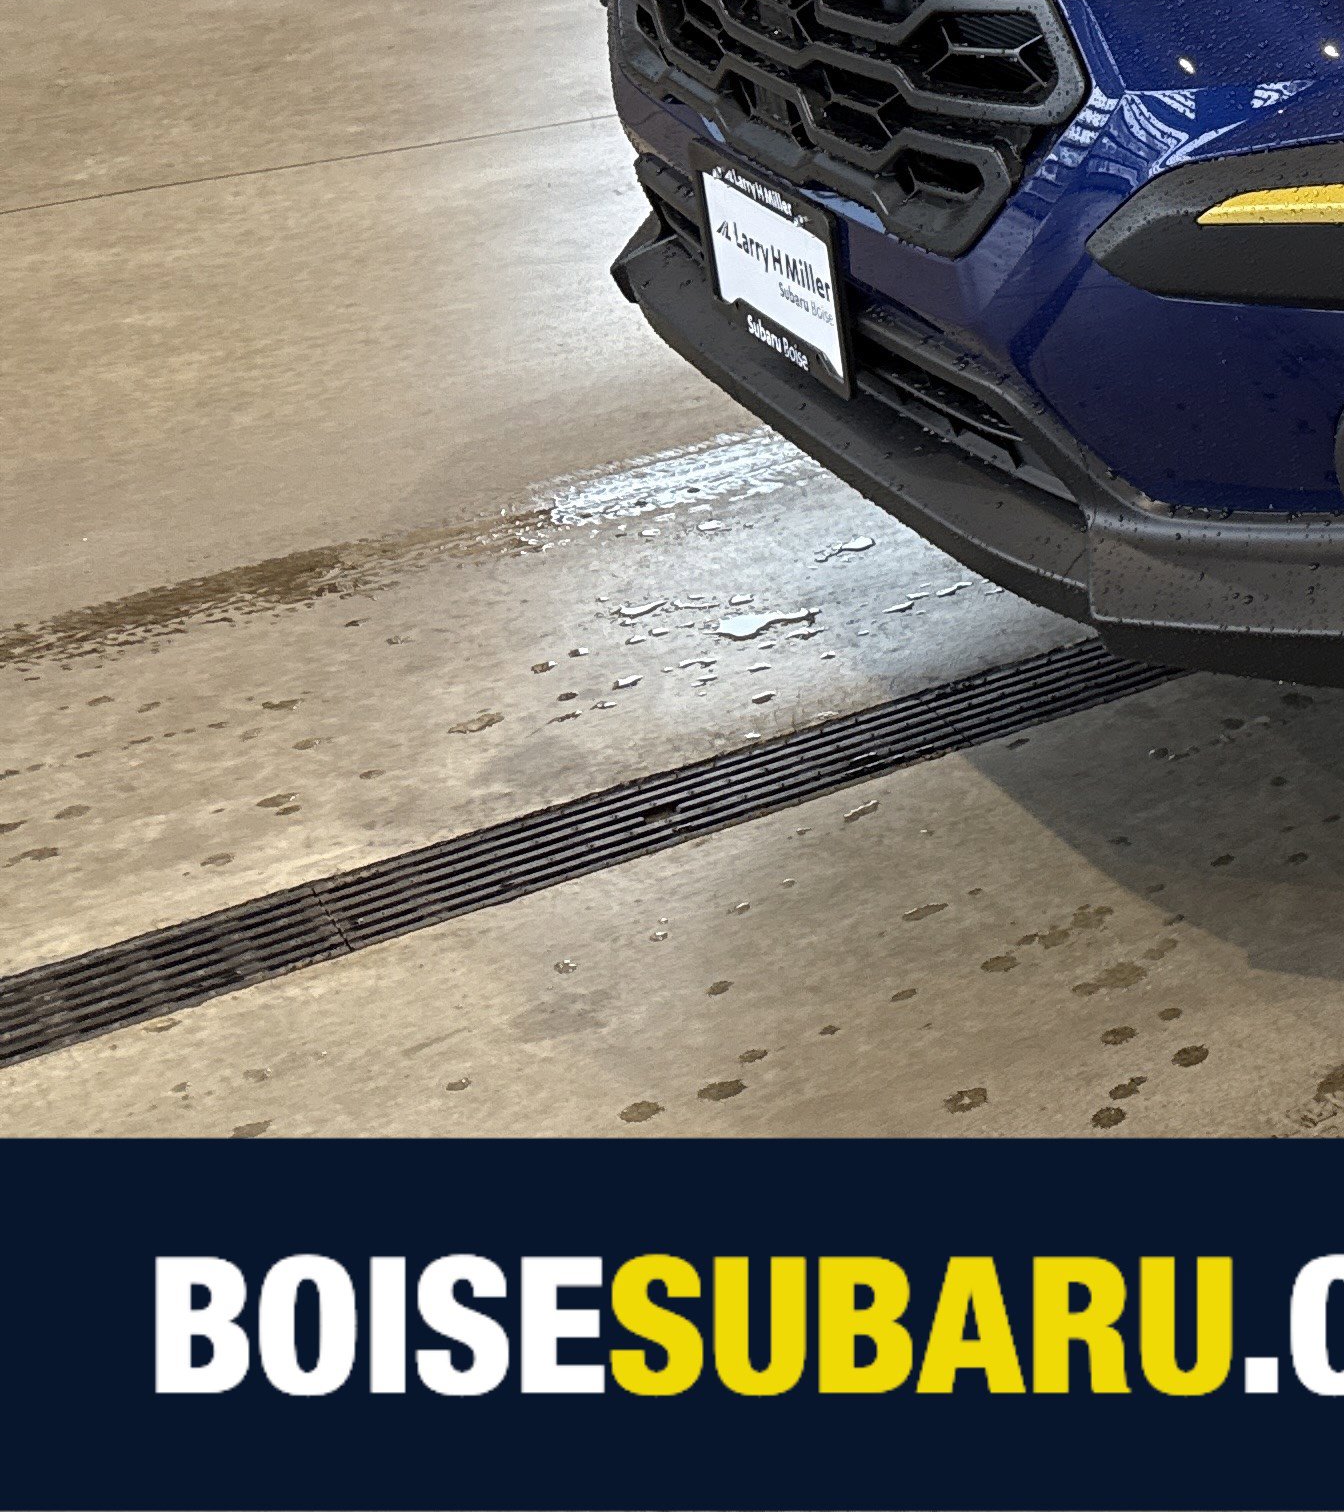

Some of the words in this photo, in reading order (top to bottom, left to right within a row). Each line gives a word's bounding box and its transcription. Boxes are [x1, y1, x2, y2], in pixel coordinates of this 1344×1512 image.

[732, 169, 756, 200] Larry
[764, 187, 793, 217] Miller
[732, 221, 770, 273] Larry
[770, 245, 784, 276] H
[785, 253, 831, 303] Miller
[778, 281, 810, 313] Subaru
[811, 300, 834, 327] Boise
[747, 314, 782, 354] Subaru
[783, 337, 810, 372] Boise
